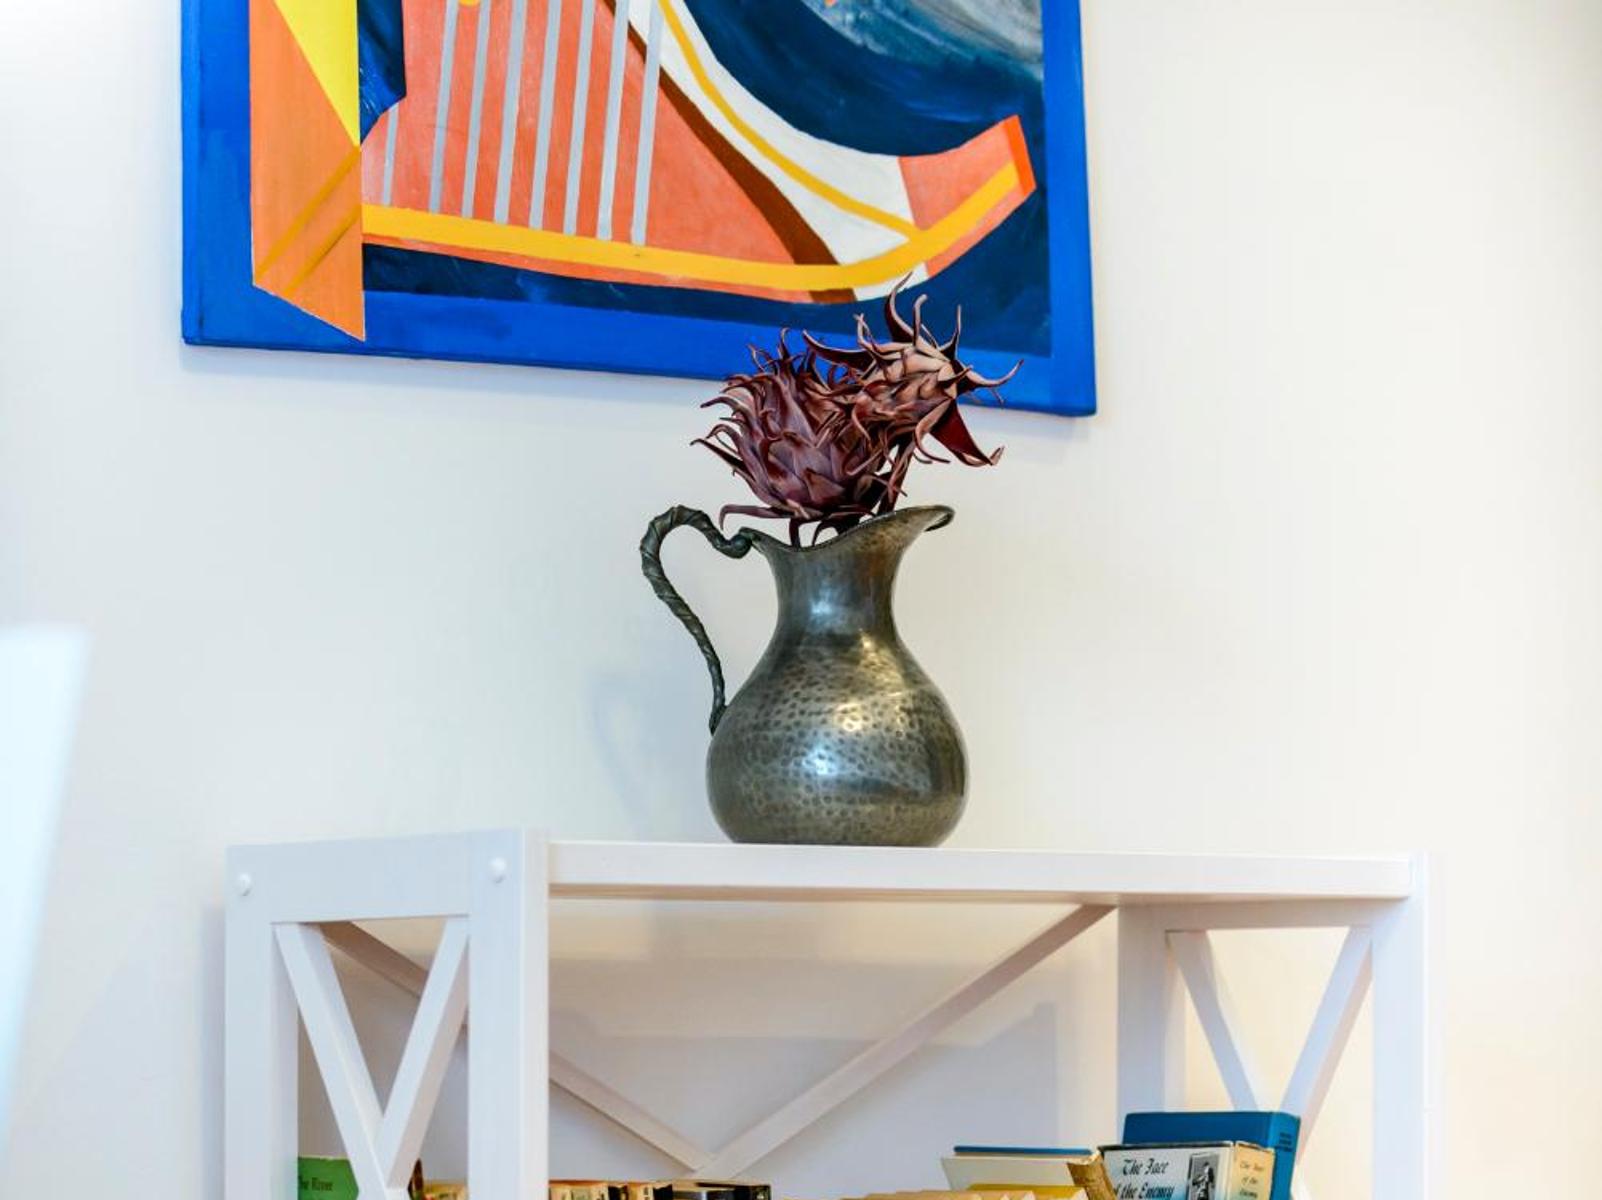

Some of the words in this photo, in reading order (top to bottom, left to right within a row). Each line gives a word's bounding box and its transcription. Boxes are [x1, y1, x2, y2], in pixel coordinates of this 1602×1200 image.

[1122, 1158, 1143, 1176] The
[1145, 1157, 1169, 1175] Face
[1120, 1182, 1138, 1199] the
